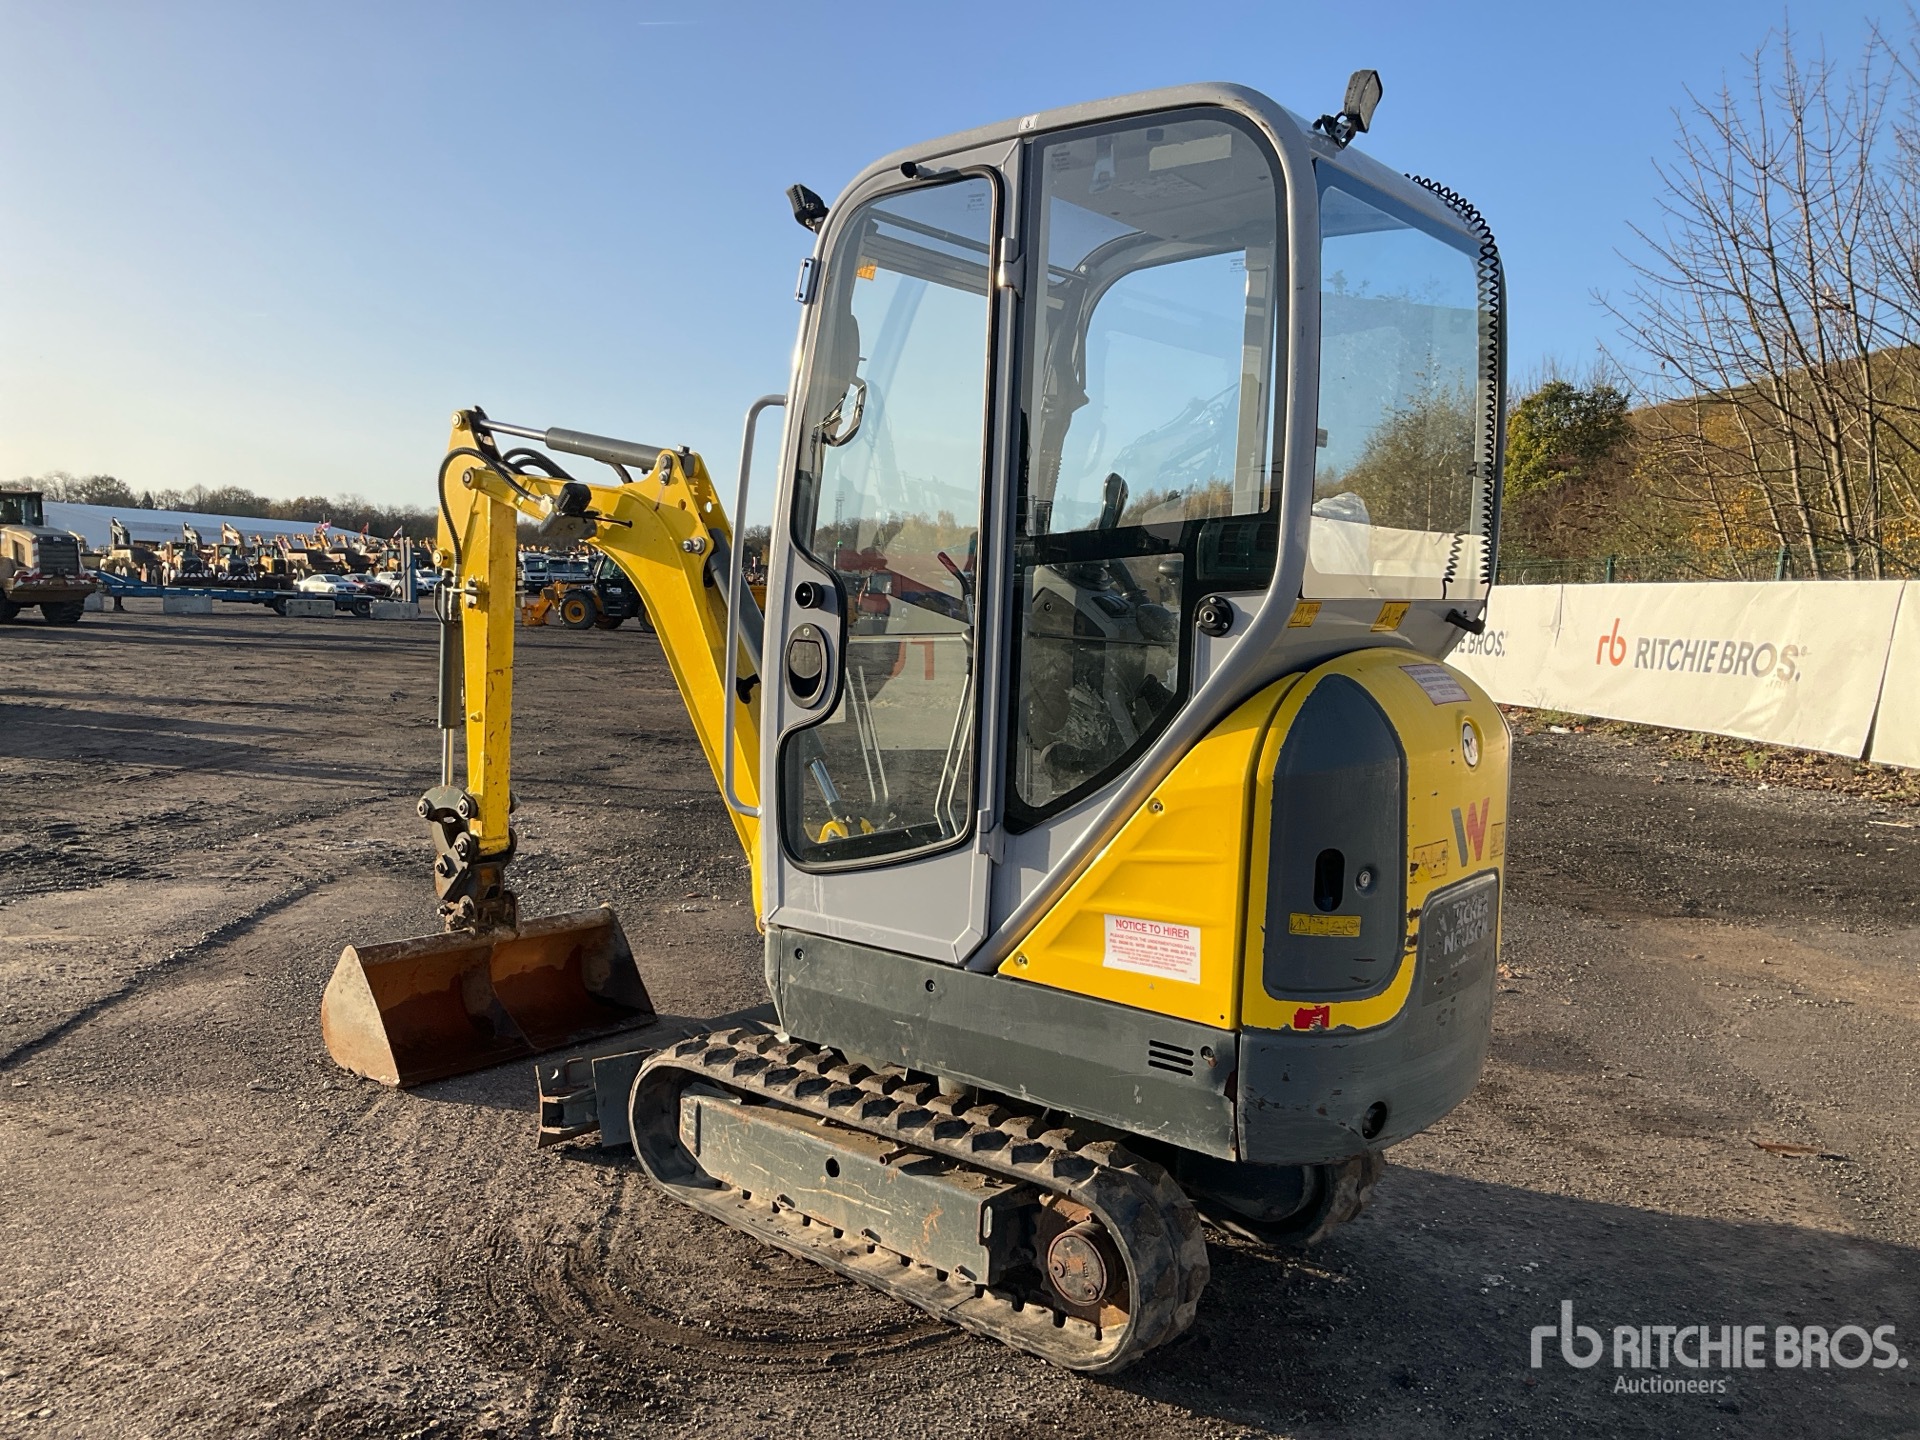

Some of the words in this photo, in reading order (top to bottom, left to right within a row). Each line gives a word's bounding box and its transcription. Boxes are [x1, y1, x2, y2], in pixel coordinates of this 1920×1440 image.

[1596, 618, 1627, 667] rb
[1634, 637, 1719, 673] RITCHIE
[1717, 640, 1801, 682] BROS.
[1115, 919, 1148, 932] NOTICE
[1149, 924, 1161, 935] TO
[1163, 926, 1190, 939] HIRER
